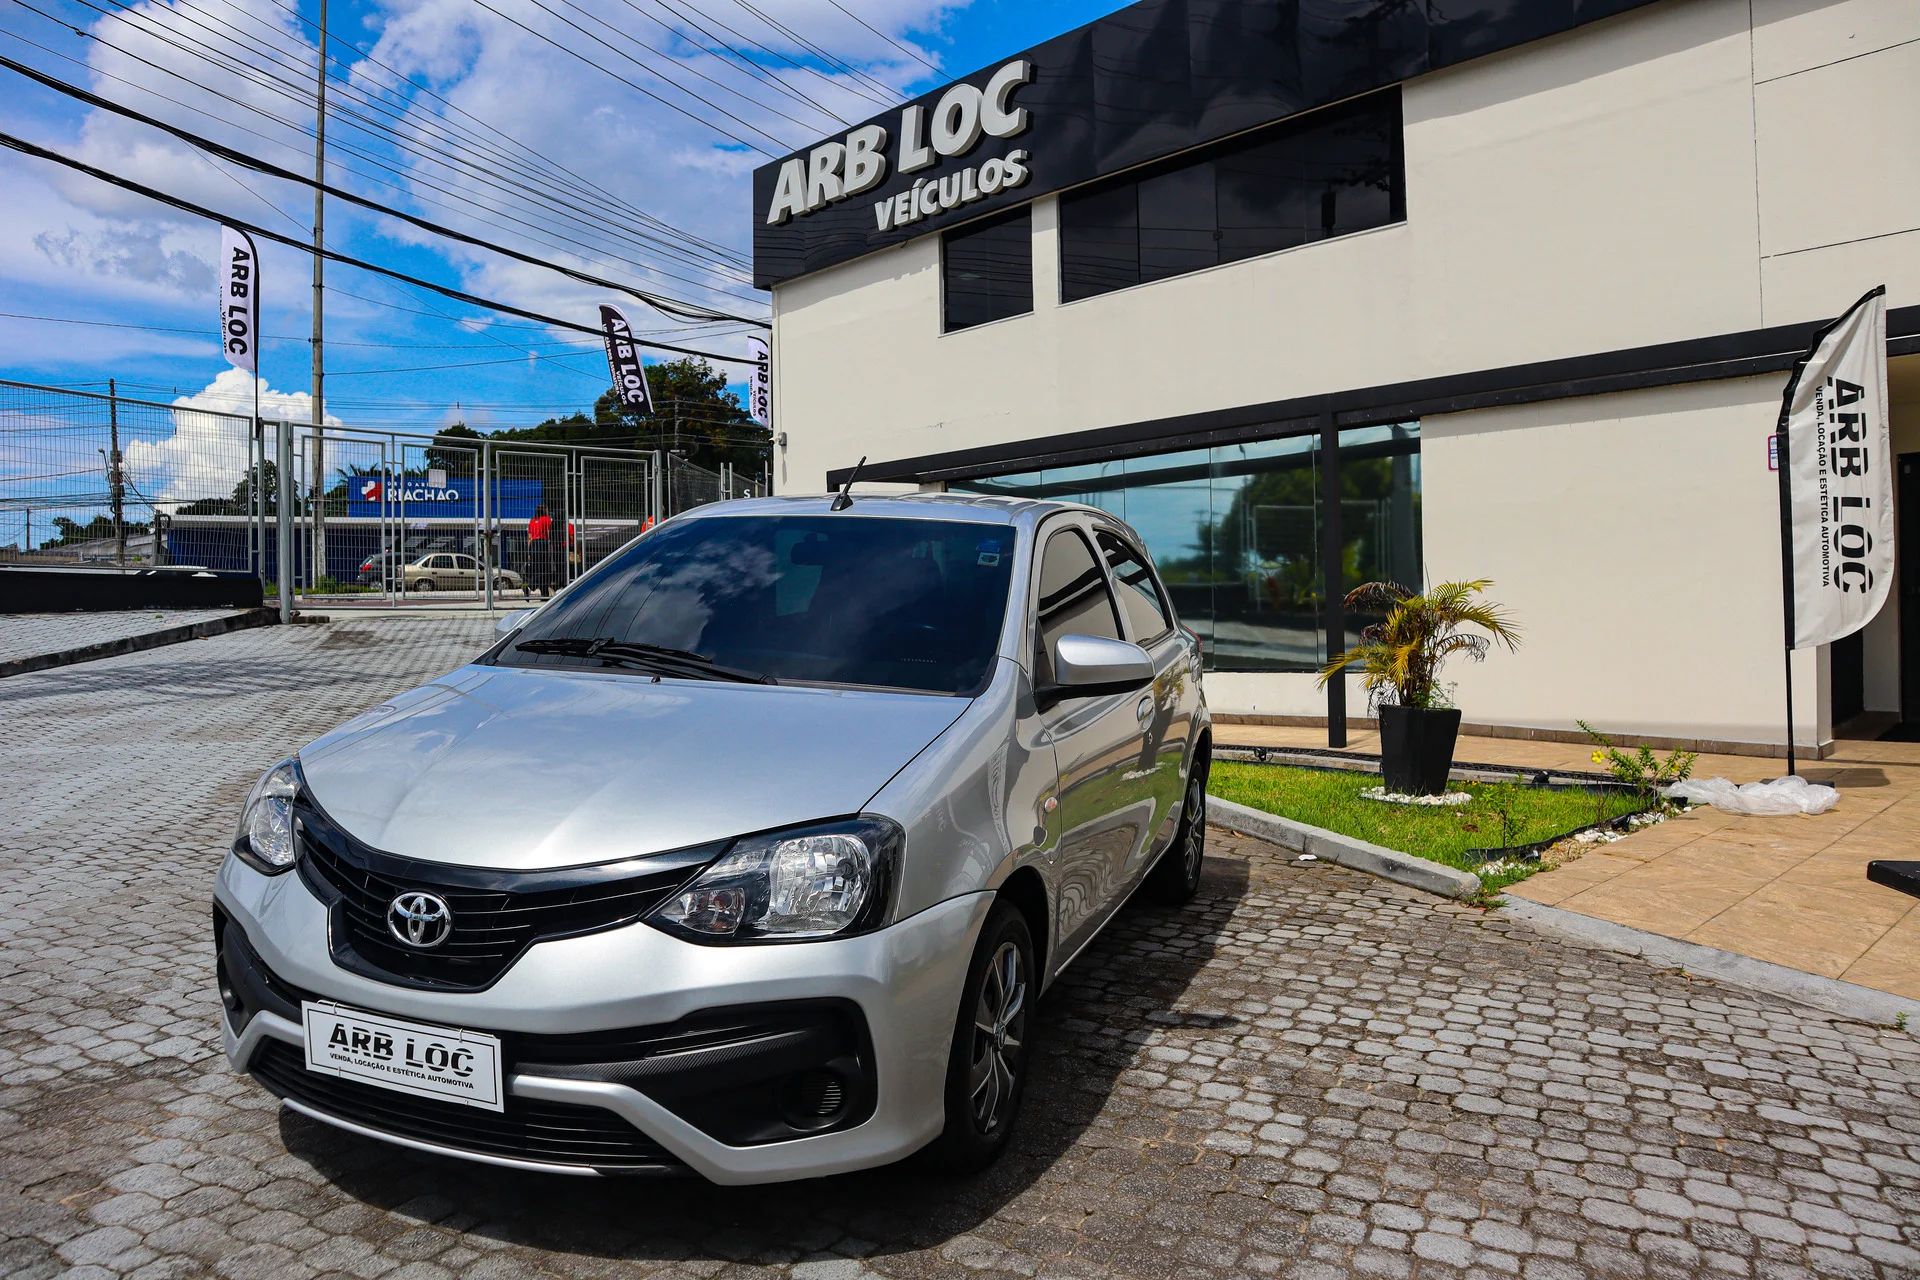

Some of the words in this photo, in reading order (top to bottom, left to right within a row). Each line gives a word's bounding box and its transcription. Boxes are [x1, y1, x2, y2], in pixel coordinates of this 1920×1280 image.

[767, 125, 886, 225] ARB
[898, 59, 1031, 174] LOC
[874, 149, 1029, 231] VEÍCULOS
[231, 247, 250, 298] ARB
[228, 305, 248, 355] LOC
[602, 323, 610, 348] LOÇÃO
[611, 318, 633, 359] ARB
[616, 370, 628, 405] VEÍCULOS
[620, 364, 644, 403] LOC
[757, 350, 769, 384] ARB
[758, 386, 768, 418] LOC
[1815, 385, 1825, 420] VENDA,
[1816, 422, 1828, 467] LOCAÇÃO
[1827, 376, 1868, 478] ARB
[1819, 478, 1829, 523] ESTÉTICA
[1821, 526, 1830, 587] AUTOMOTIVA
[1833, 496, 1874, 594] LOC
[328, 1023, 394, 1061] ARB
[405, 1037, 474, 1078] LOC
[330, 1052, 354, 1065] VENDA,
[354, 1058, 386, 1070] LOCAÇÃO
[392, 1067, 426, 1080] ESTÉTICA
[427, 1074, 474, 1090] AUTOMOTIVA
